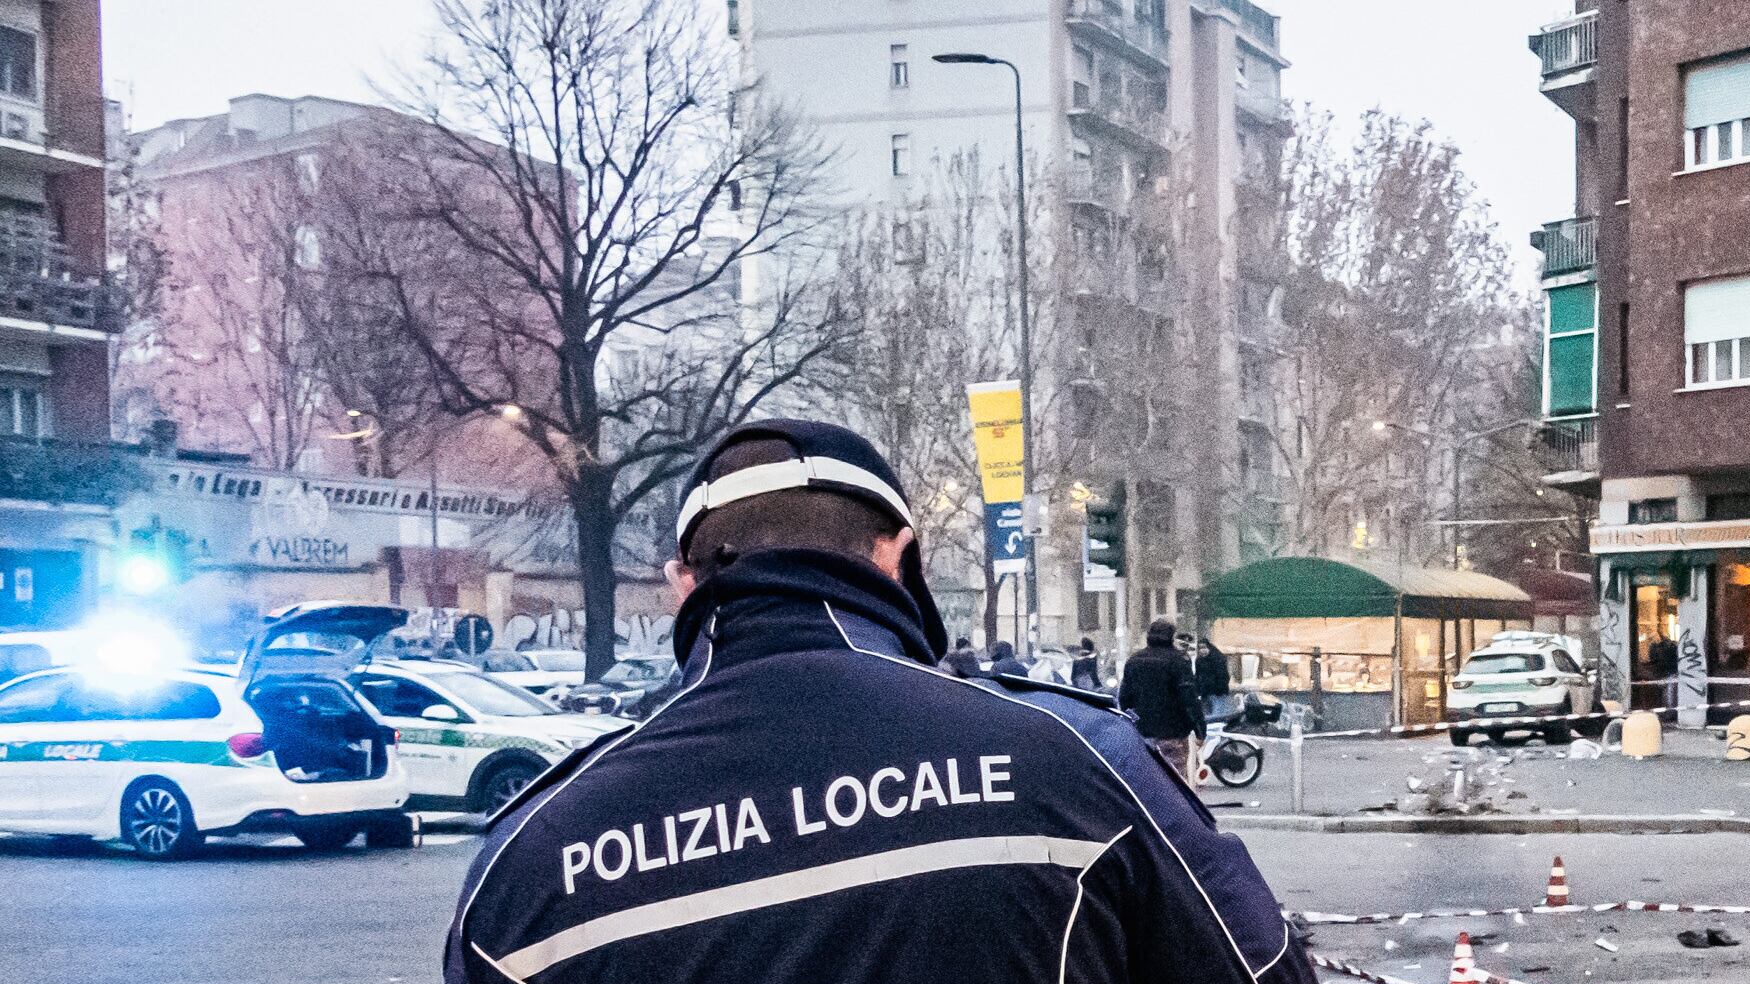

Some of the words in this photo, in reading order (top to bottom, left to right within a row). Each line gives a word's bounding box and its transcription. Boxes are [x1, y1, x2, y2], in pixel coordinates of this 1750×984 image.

[43, 744, 103, 759] LOCALE
[562, 797, 772, 895] POLIZIA
[791, 754, 1016, 836] LOCALE
